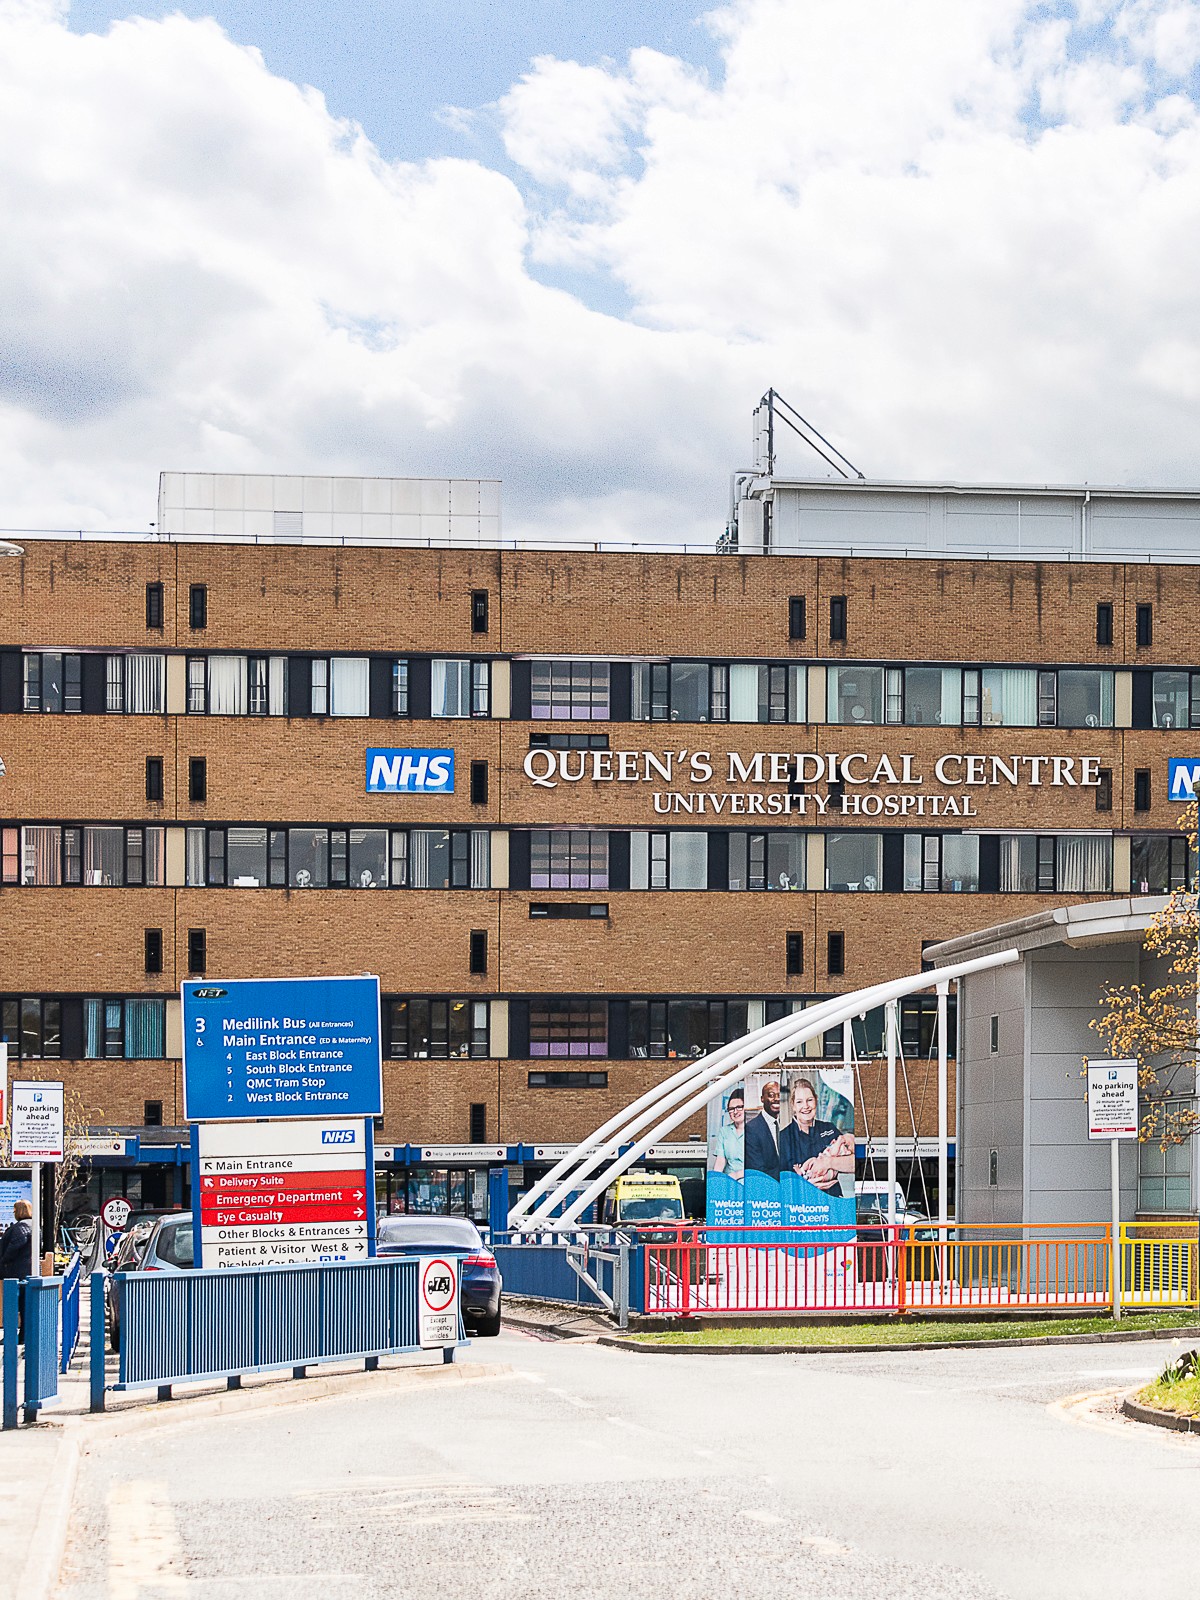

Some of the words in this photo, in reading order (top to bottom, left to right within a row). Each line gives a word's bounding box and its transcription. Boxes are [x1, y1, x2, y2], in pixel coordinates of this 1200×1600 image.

[370, 755, 451, 786] NHS
[523, 749, 713, 788] QUEEN'S
[726, 752, 922, 784] MEDICAL
[935, 754, 1102, 786] CENTRE
[653, 792, 832, 815] UNIVERSITY
[840, 794, 977, 816] HOSPITAL
[195, 1018, 206, 1033] 3
[222, 1018, 280, 1030] Medilink
[283, 1018, 306, 1029] Bus
[223, 1035, 256, 1047] Main
[260, 1034, 316, 1046] Entrance
[319, 1037, 331, 1045] (ED
[338, 1036, 372, 1045] Maternity)
[245, 1051, 268, 1061] East
[270, 1050, 296, 1060] Block
[299, 1050, 344, 1059] Entrance
[246, 1065, 276, 1075] South
[279, 1064, 306, 1074] Block
[308, 1063, 353, 1073] Entrance
[246, 1079, 272, 1089] QMC
[274, 1079, 299, 1087] Tram
[302, 1078, 326, 1089] Stop
[1104, 1082, 1134, 1090] parking
[247, 1093, 274, 1102] West
[275, 1092, 303, 1101] Block
[304, 1091, 349, 1101] Entrance
[30, 1104, 59, 1113] parking
[324, 1131, 354, 1143] NHS
[216, 1162, 243, 1170] Main
[246, 1160, 293, 1169] Entrance
[220, 1177, 258, 1188] Delivery
[260, 1176, 284, 1185] Suite
[216, 1195, 275, 1206] Emergency
[277, 1192, 342, 1205] Department
[217, 1212, 236, 1224] Eye
[238, 1210, 283, 1222] Casualty
[724, 1208, 744, 1217] Quee
[714, 1217, 744, 1225] Medical
[218, 1230, 249, 1239] Other
[252, 1228, 285, 1238] Blocks
[288, 1228, 296, 1236] &
[299, 1226, 350, 1236] Entrances
[218, 1246, 257, 1256] Patient
[259, 1246, 267, 1254] &
[271, 1244, 306, 1254] Visitor
[311, 1243, 337, 1253] West
[341, 1242, 349, 1251] &
